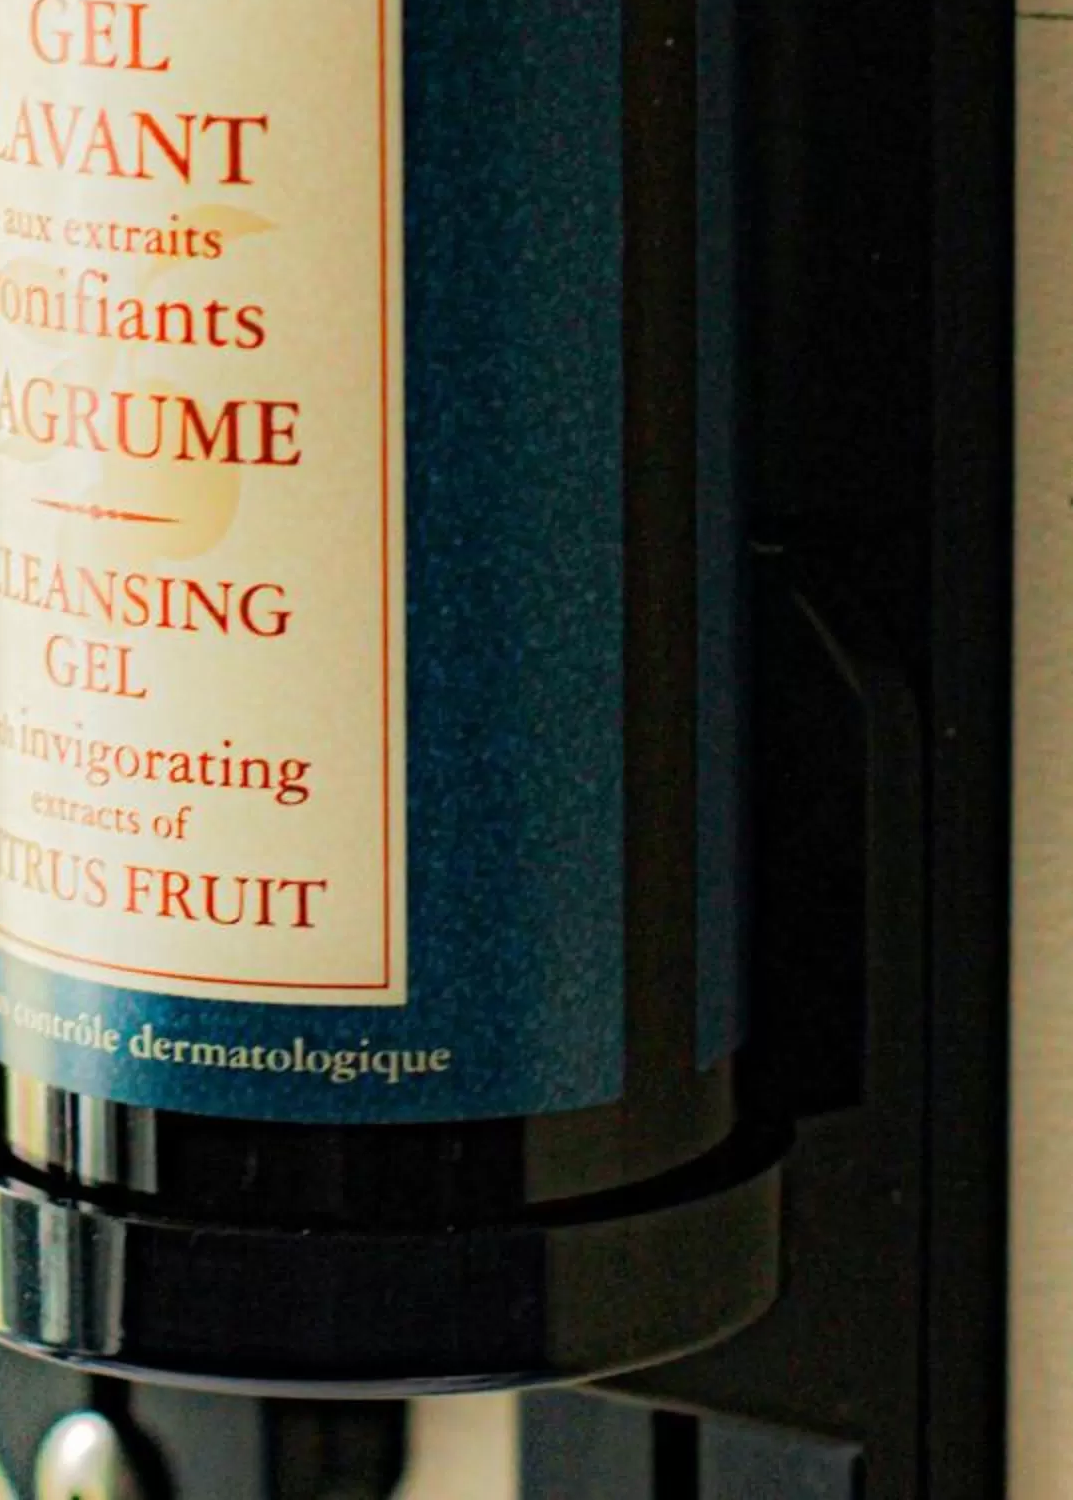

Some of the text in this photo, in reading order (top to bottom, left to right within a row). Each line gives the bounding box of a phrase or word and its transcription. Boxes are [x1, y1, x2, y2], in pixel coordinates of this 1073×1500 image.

[2, 206, 224, 260] aux extraits
[44, 632, 148, 700] GEL
[19, 707, 313, 807] invigorating
[30, 787, 193, 841] extracts of
[123, 863, 328, 930] FRUIT
[13, 1003, 452, 1083] contrôle dermatologique
